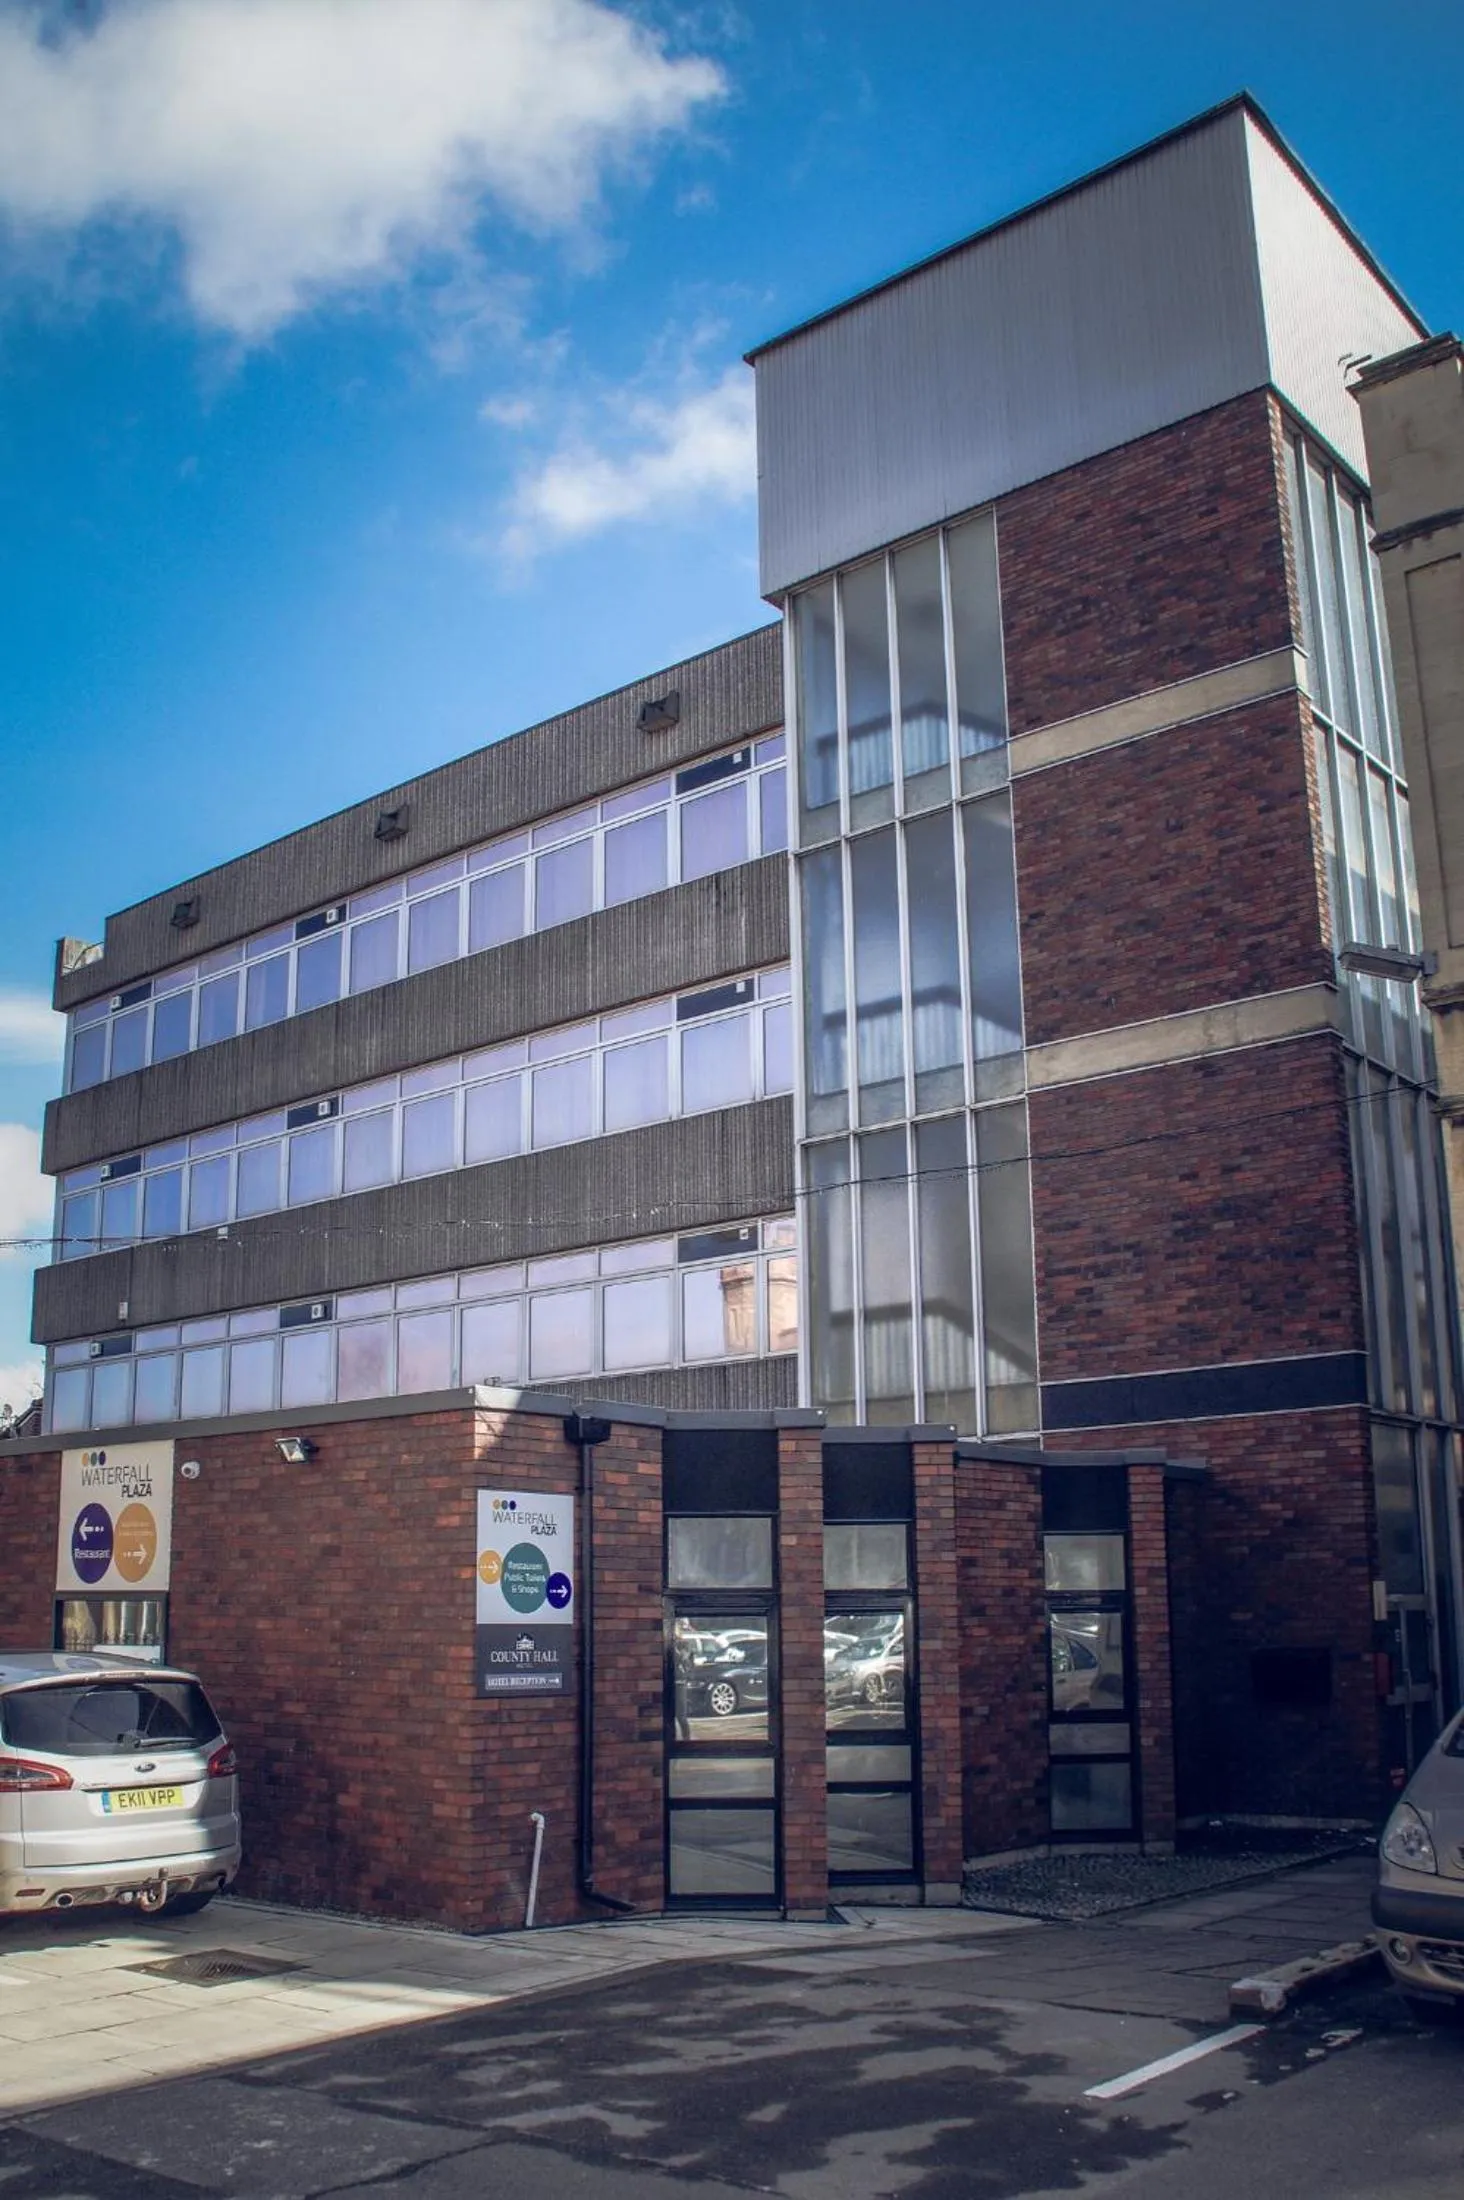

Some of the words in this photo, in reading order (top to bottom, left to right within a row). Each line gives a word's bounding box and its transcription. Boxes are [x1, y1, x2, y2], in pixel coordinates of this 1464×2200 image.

[81, 1464, 153, 1486] WATERFALL
[121, 1483, 152, 1498] PLAZA
[492, 1510, 557, 1526] WATERFALL
[530, 1525, 557, 1536] PLAZA
[490, 1650, 532, 1663] COUNTY
[533, 1650, 559, 1663] HALL
